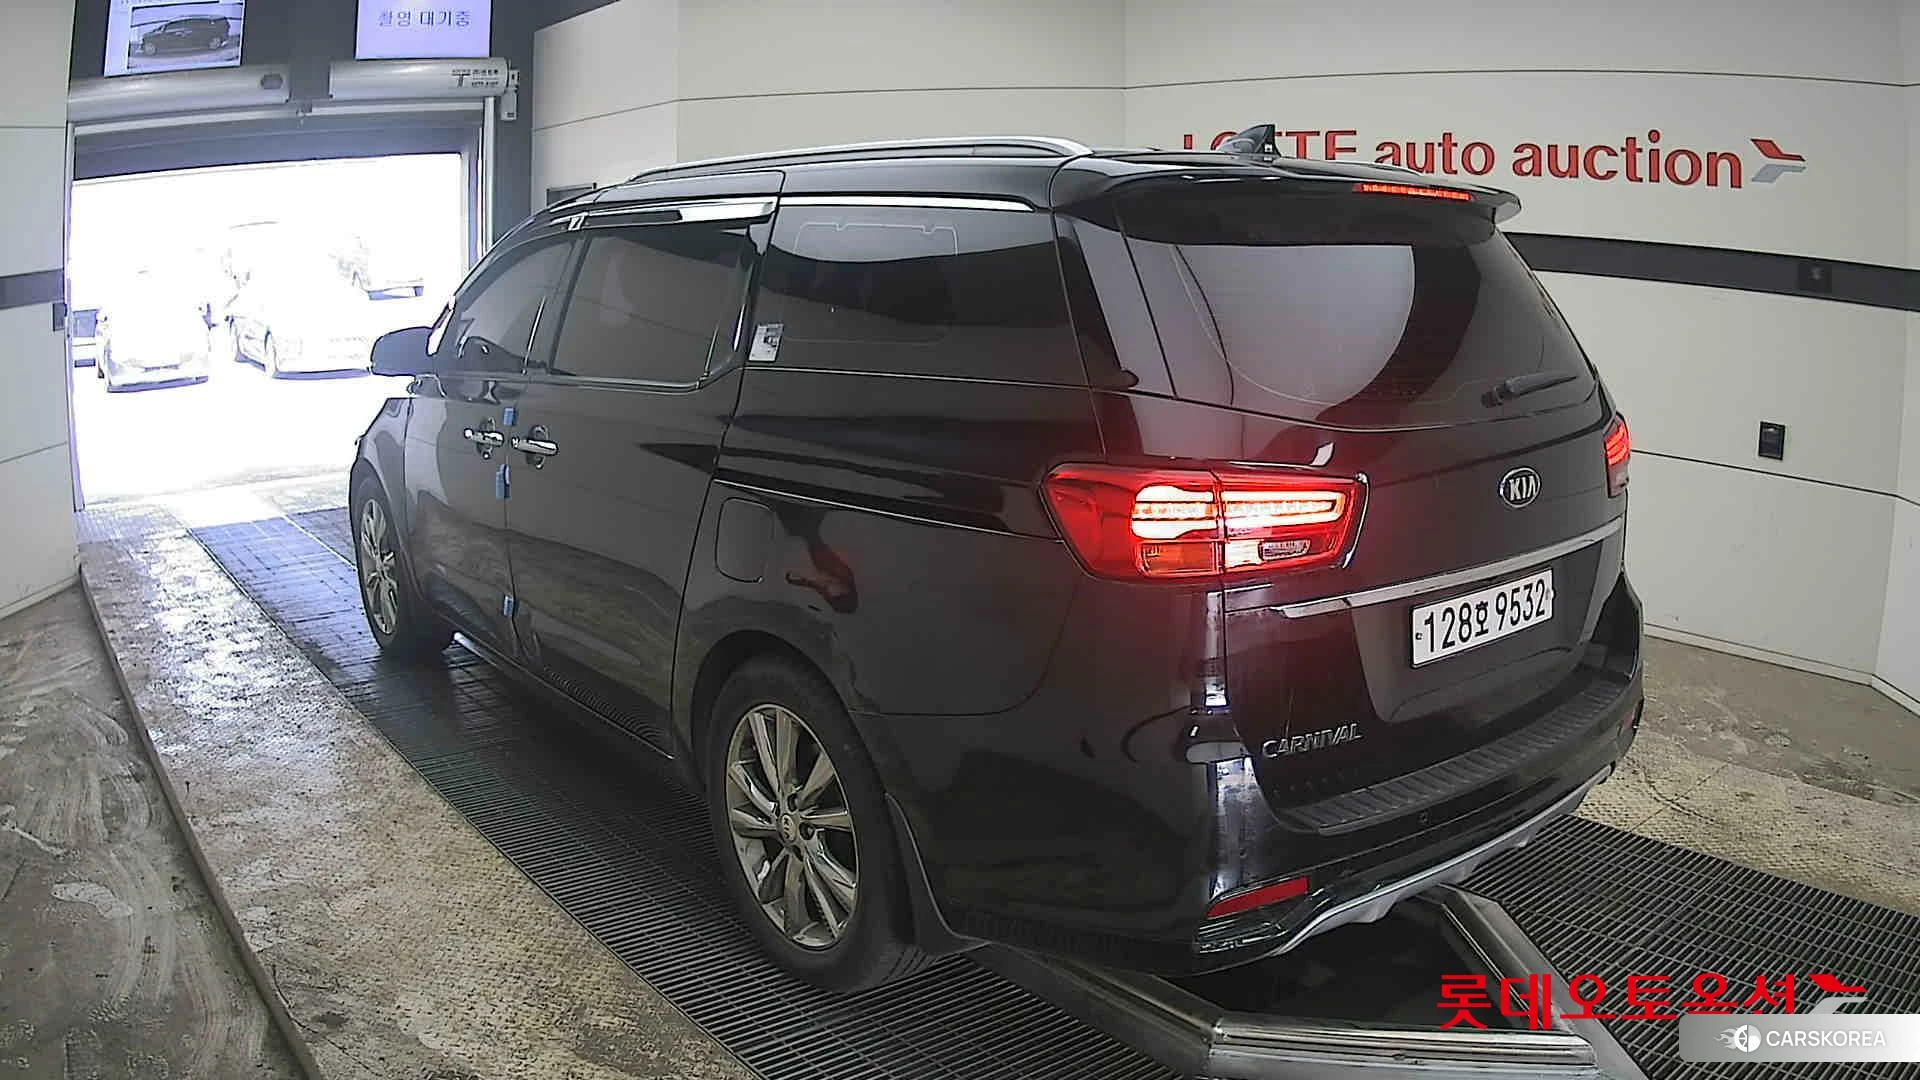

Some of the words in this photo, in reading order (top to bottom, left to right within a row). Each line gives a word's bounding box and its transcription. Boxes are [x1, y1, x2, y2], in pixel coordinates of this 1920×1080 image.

[1374, 132, 1496, 176] auto
[1512, 129, 1742, 190] auction
[1508, 474, 1537, 501] KIA
[1424, 600, 1489, 653] 128호
[1495, 578, 1545, 631] 9532
[1262, 722, 1363, 758] CARNIVAL
